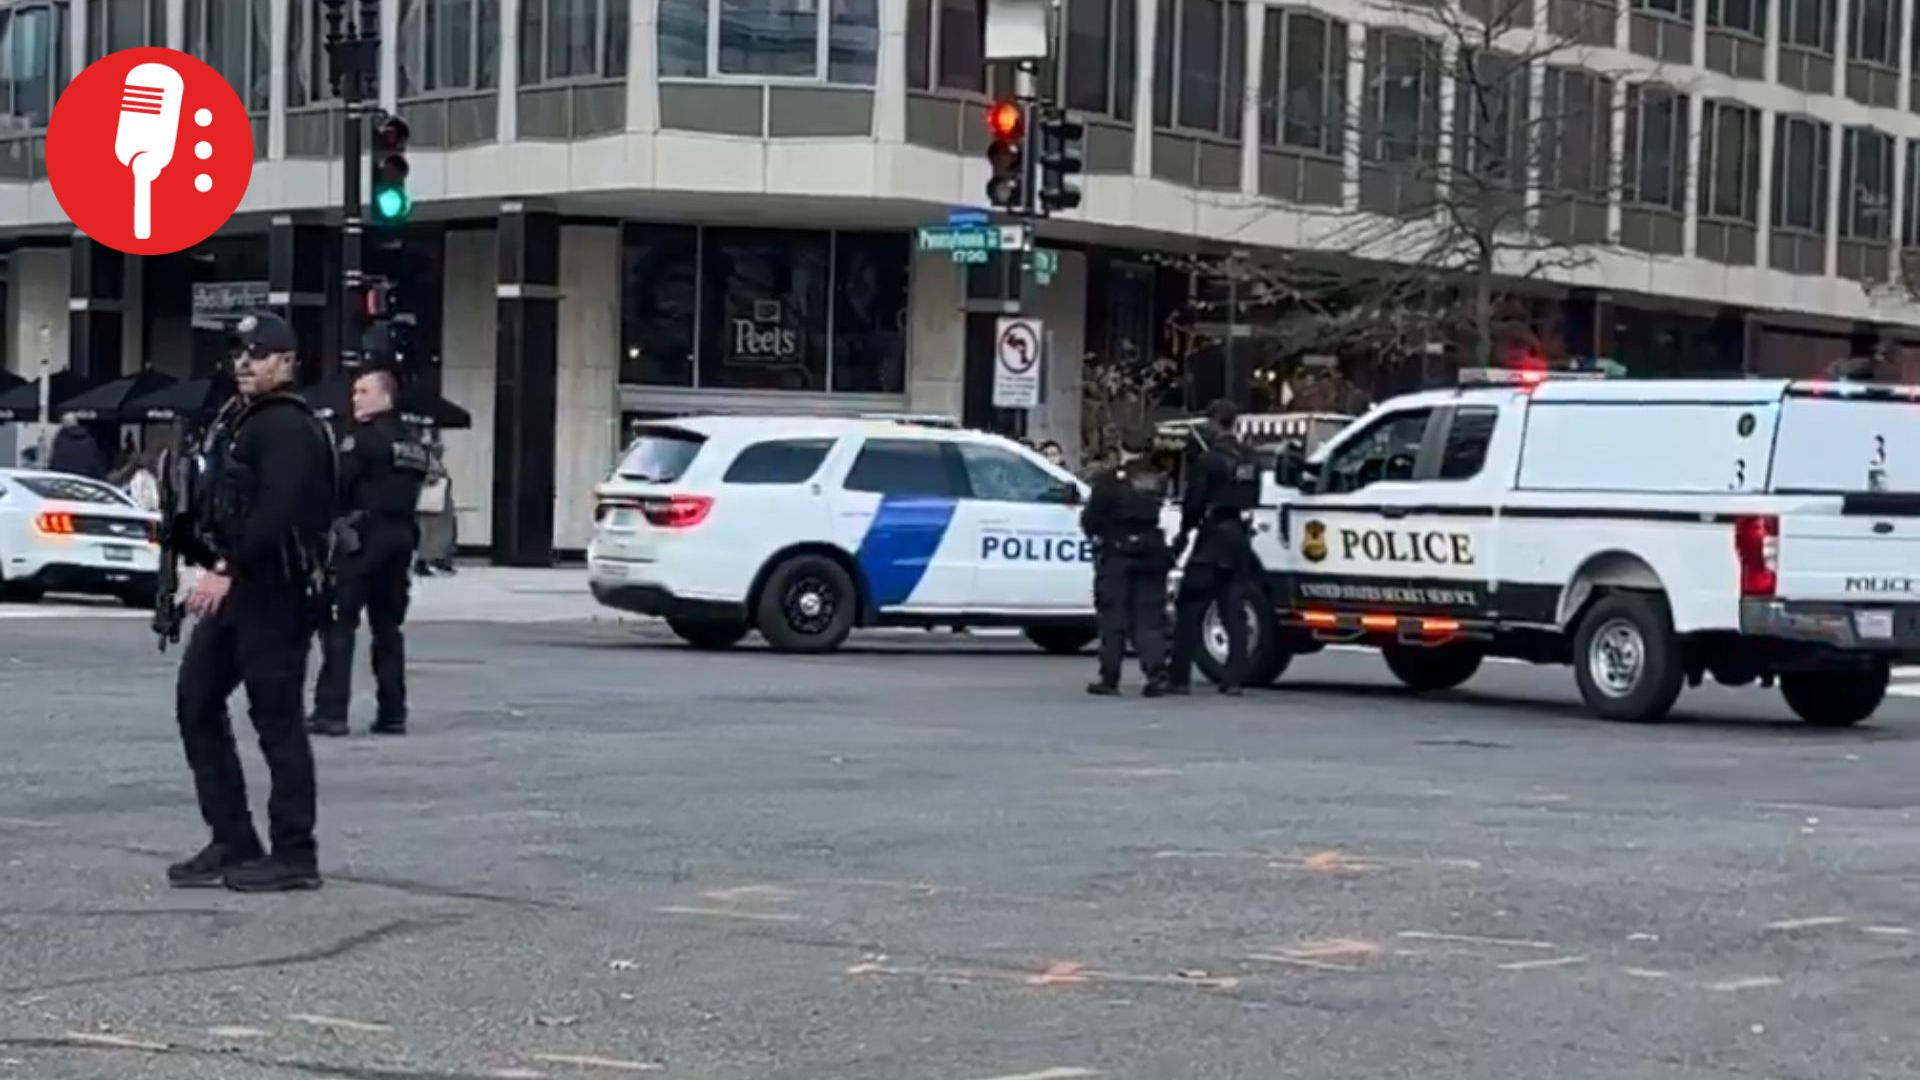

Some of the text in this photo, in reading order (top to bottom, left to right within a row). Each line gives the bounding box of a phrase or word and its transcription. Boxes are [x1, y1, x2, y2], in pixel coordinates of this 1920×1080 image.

[1870, 434, 1886, 466] 3
[1729, 458, 1746, 490] 3
[981, 536, 1096, 562] POLICE
[1340, 529, 1475, 565] POLICE
[1844, 576, 1912, 593] POLICE
